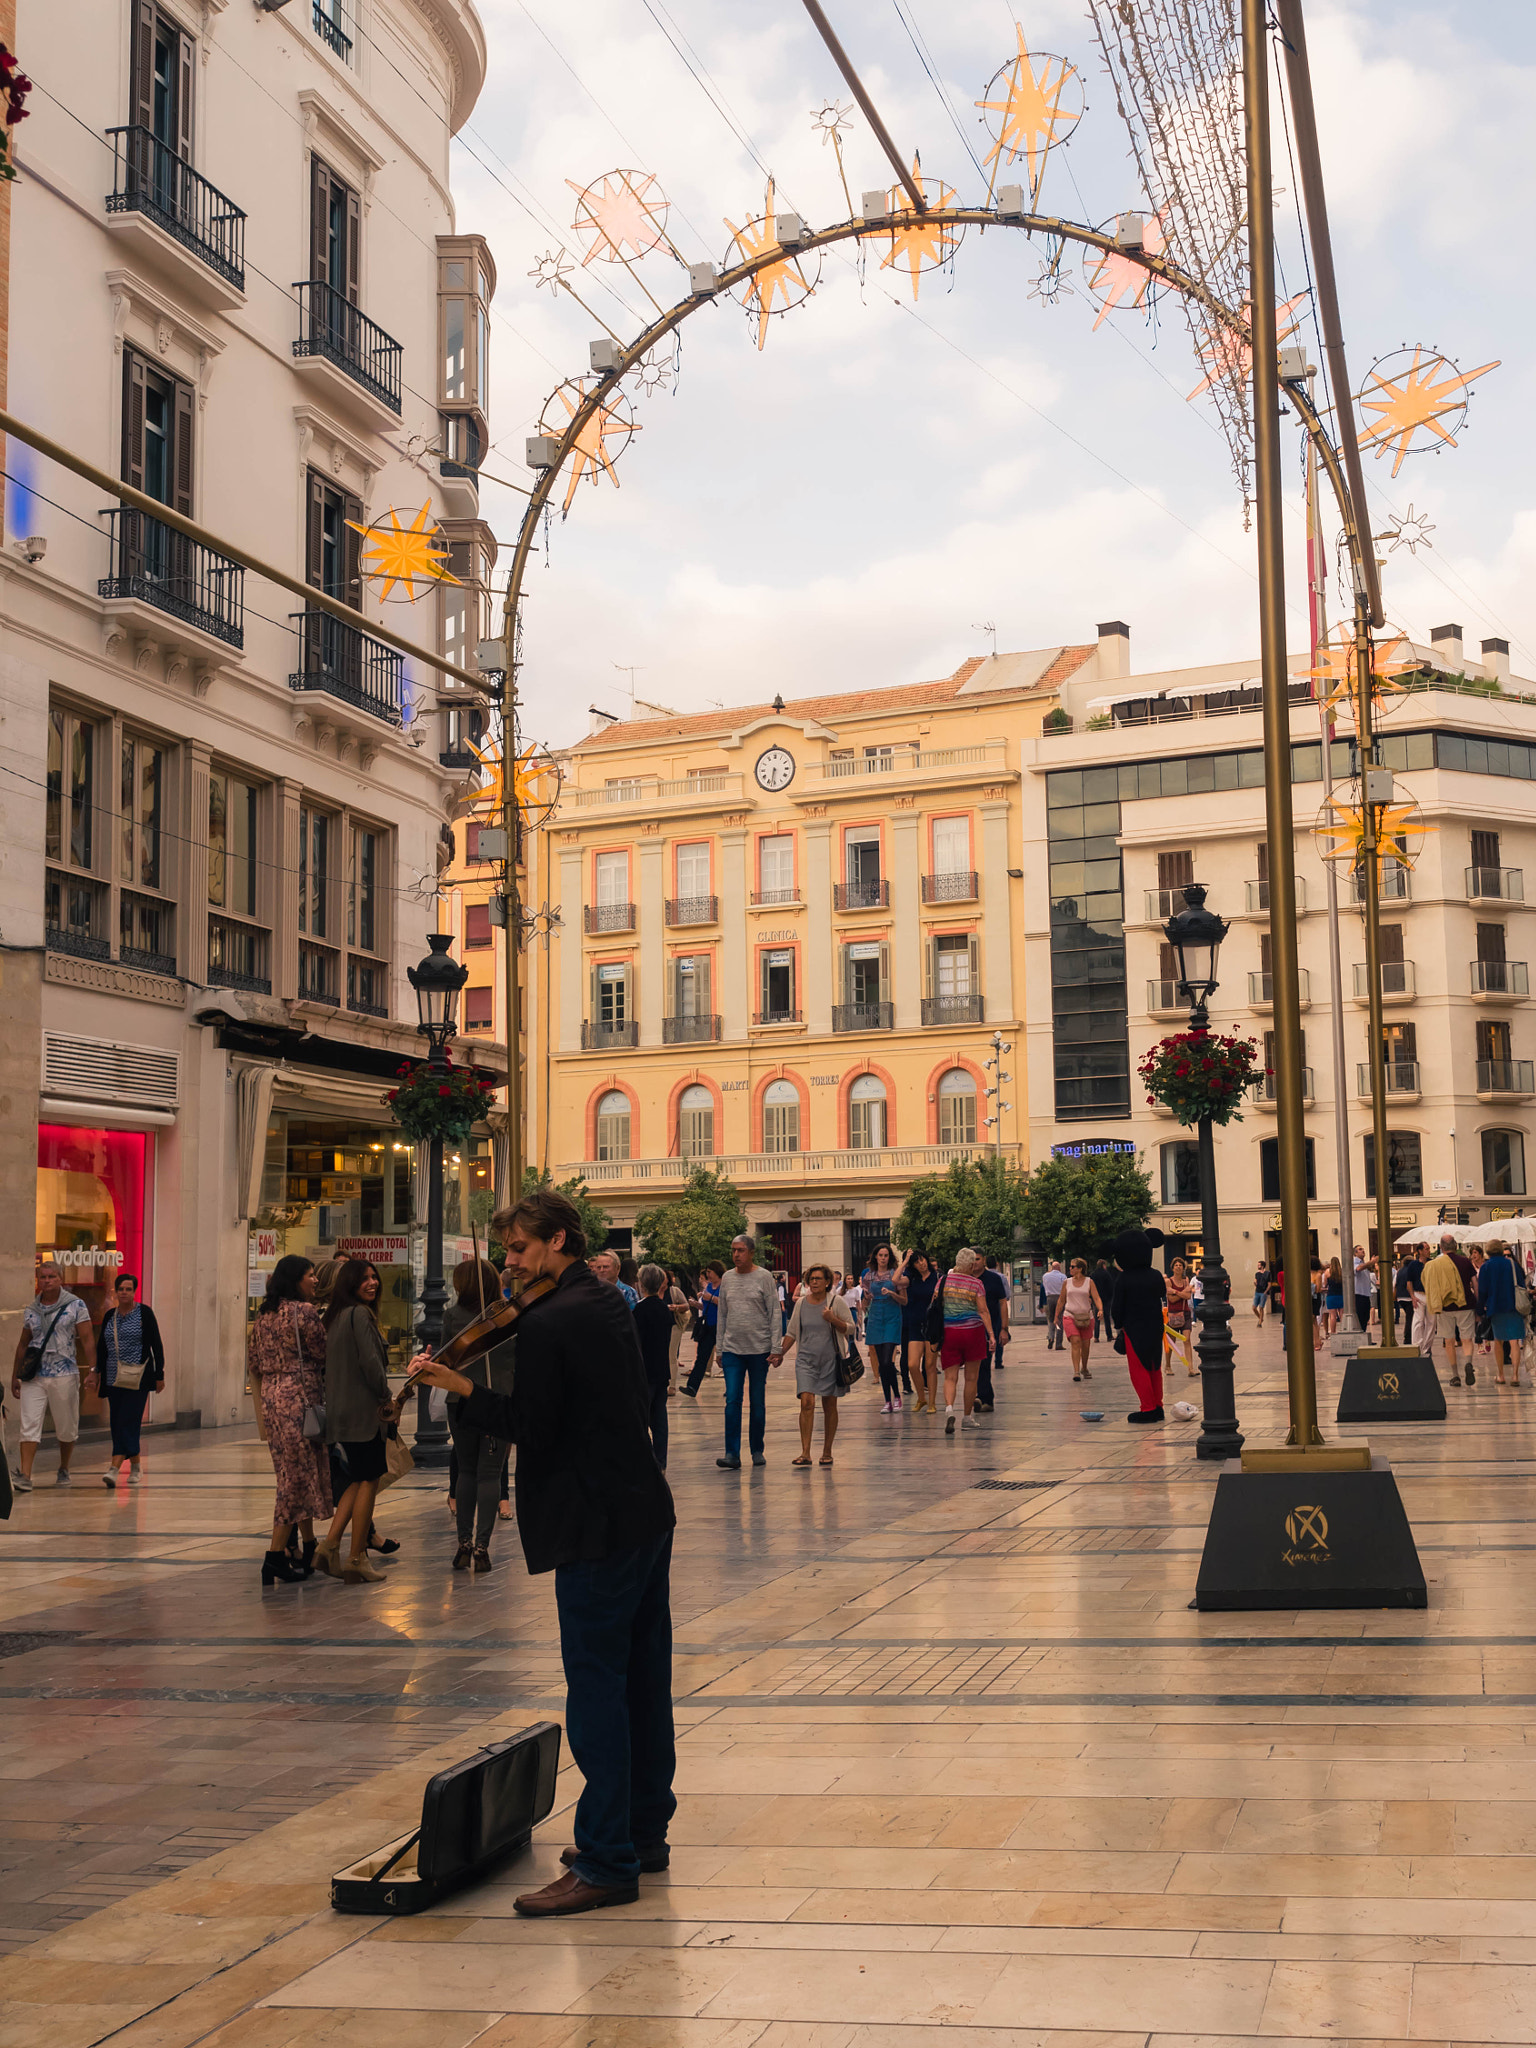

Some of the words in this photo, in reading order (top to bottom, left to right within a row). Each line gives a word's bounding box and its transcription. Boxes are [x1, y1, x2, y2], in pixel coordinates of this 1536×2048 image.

[757, 929, 799, 942] CLINICA
[721, 1080, 749, 1091] MARTI
[810, 1074, 840, 1086] TORRES
[1050, 1141, 1136, 1158] imaginarium
[803, 1204, 856, 1218] Santander
[258, 1234, 275, 1257] 50%
[337, 1237, 384, 1250] LIQUIDACION
[386, 1237, 407, 1249] TOTAL
[53, 1244, 124, 1267] vodafone
[368, 1251, 393, 1263] CIERRE
